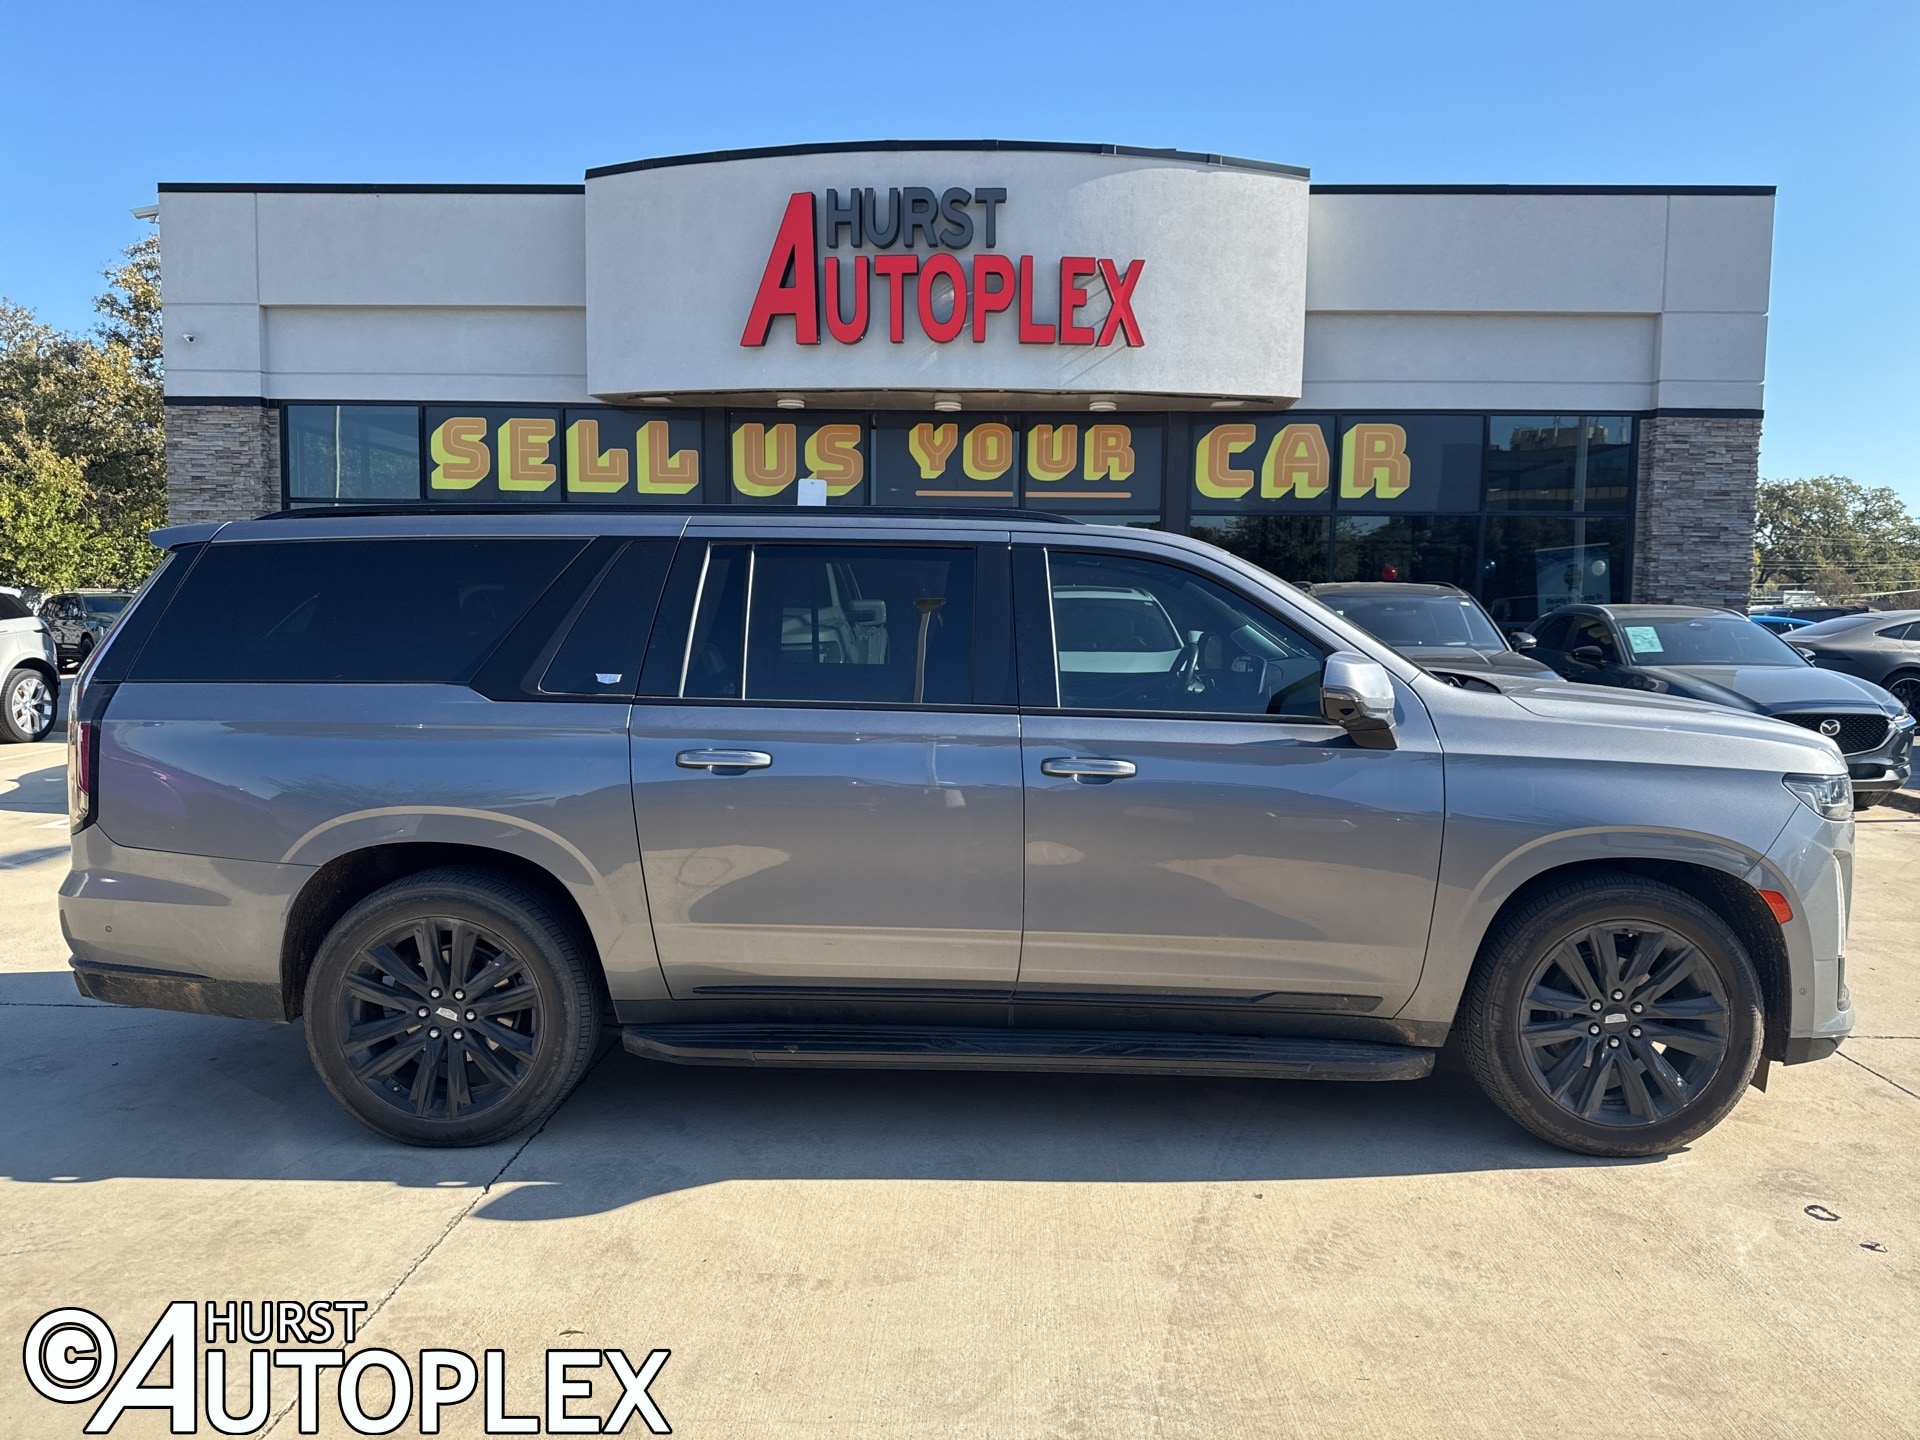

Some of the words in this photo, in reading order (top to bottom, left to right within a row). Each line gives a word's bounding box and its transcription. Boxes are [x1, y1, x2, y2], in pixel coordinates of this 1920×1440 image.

[826, 187, 1007, 249] HURST
[740, 191, 1146, 347] AUTOPLEX
[430, 417, 700, 495] SELL
[732, 422, 864, 497] US
[908, 422, 1136, 482] YOUR
[1195, 422, 1412, 499] CAR
